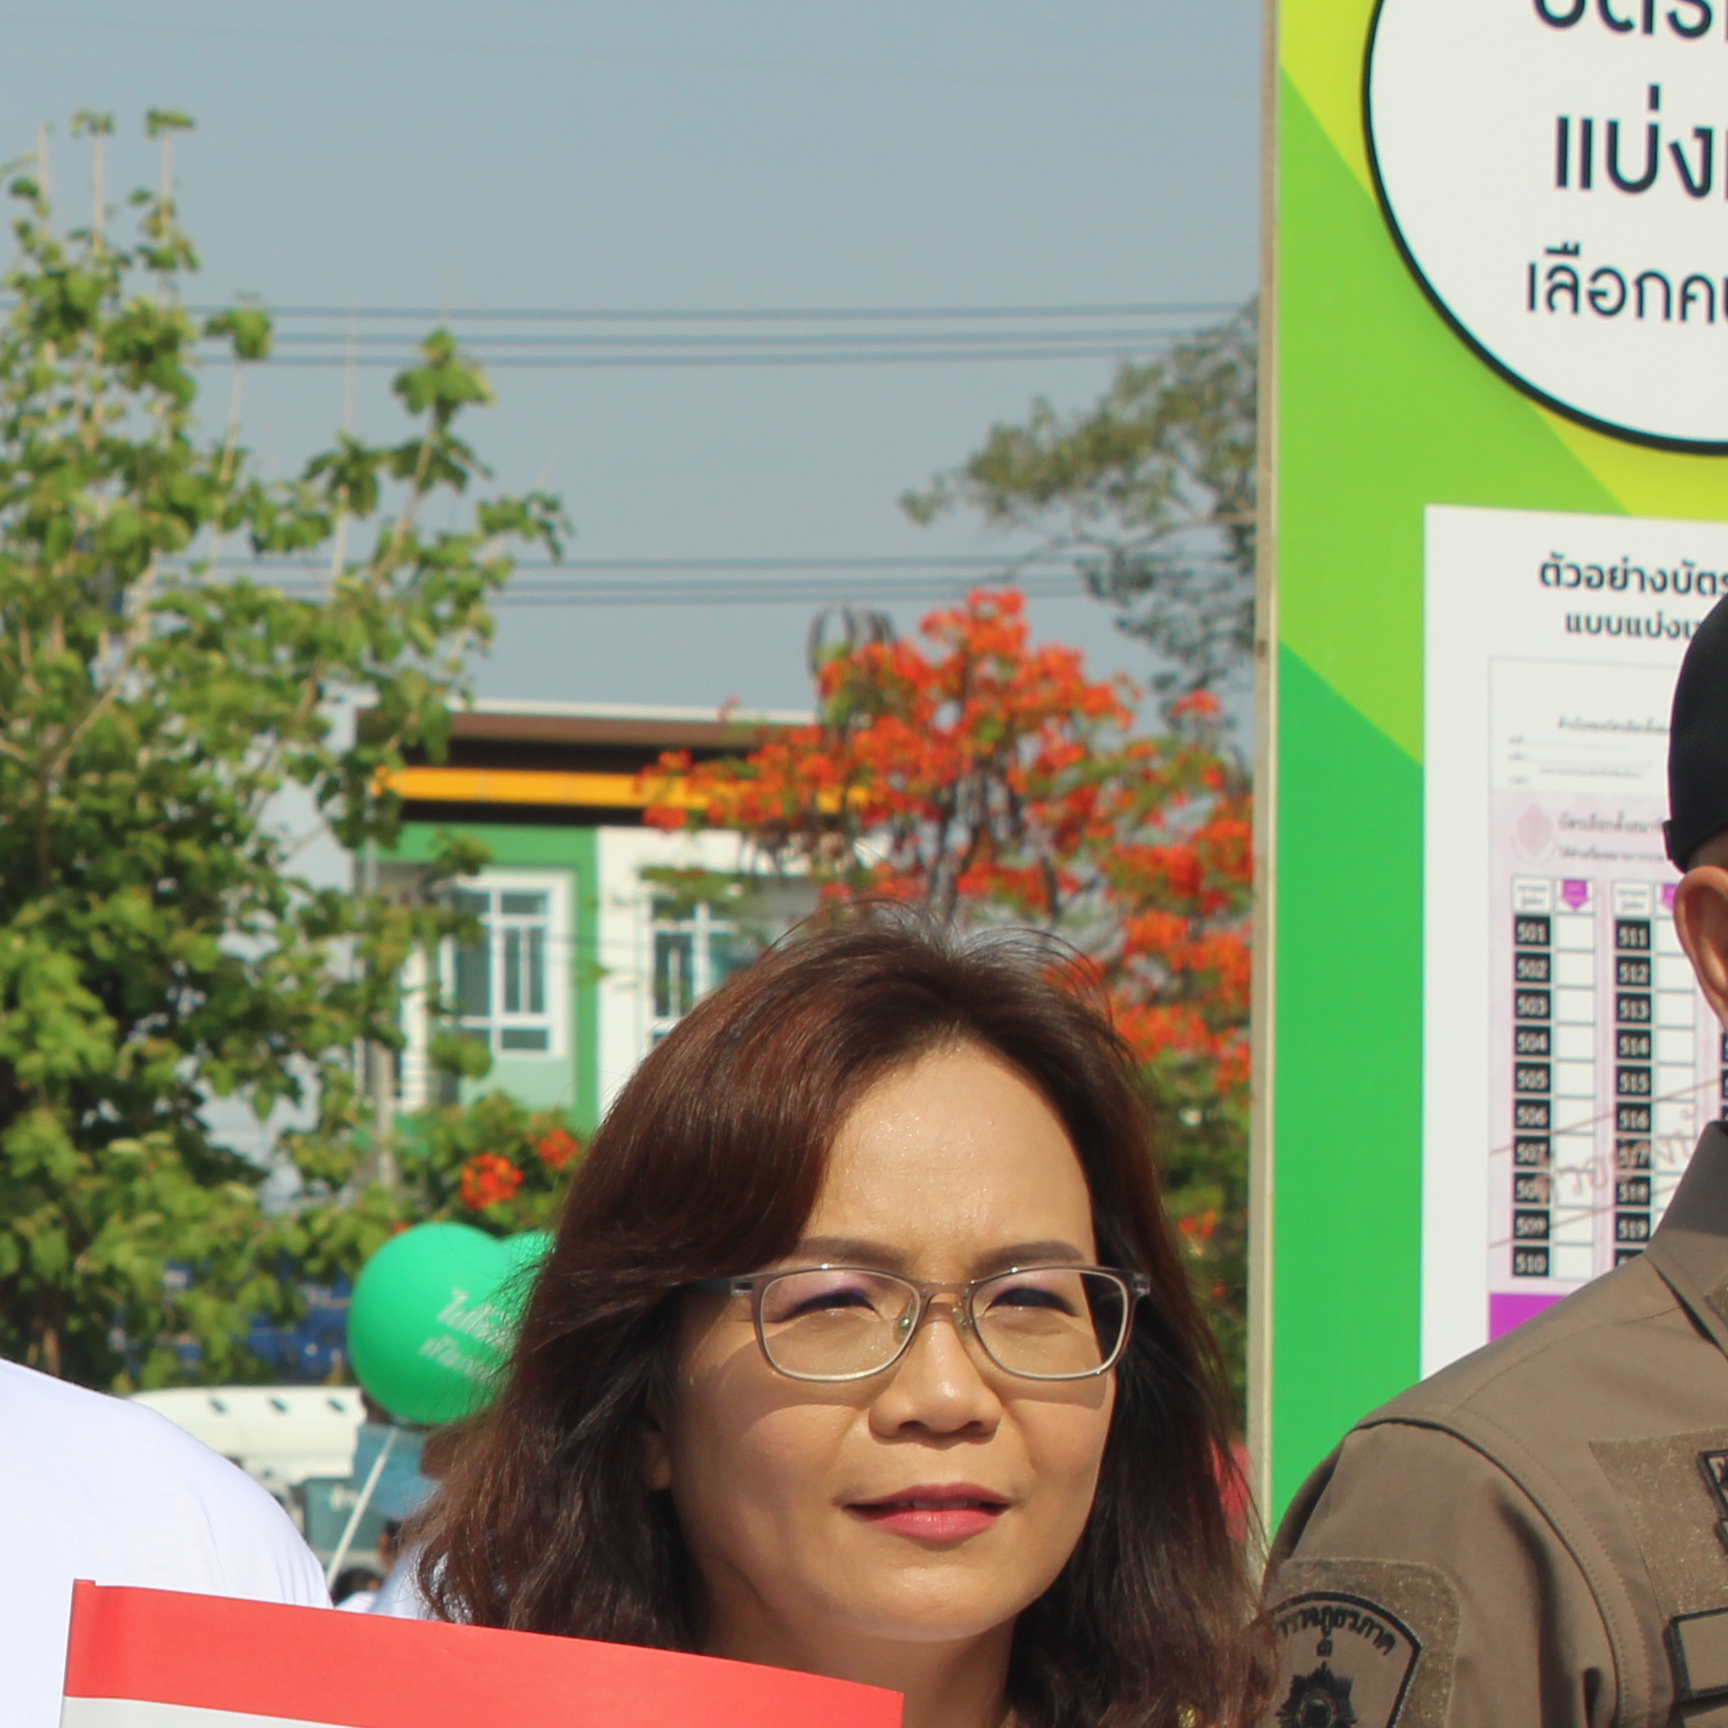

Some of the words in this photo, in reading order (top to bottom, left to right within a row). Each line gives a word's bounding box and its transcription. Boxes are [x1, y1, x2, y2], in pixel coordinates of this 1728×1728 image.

[1556, 83, 1728, 199] แบ่ง
[1527, 241, 1728, 324] เลือกค
[1566, 610, 1702, 640] แบบแบ่งเ
